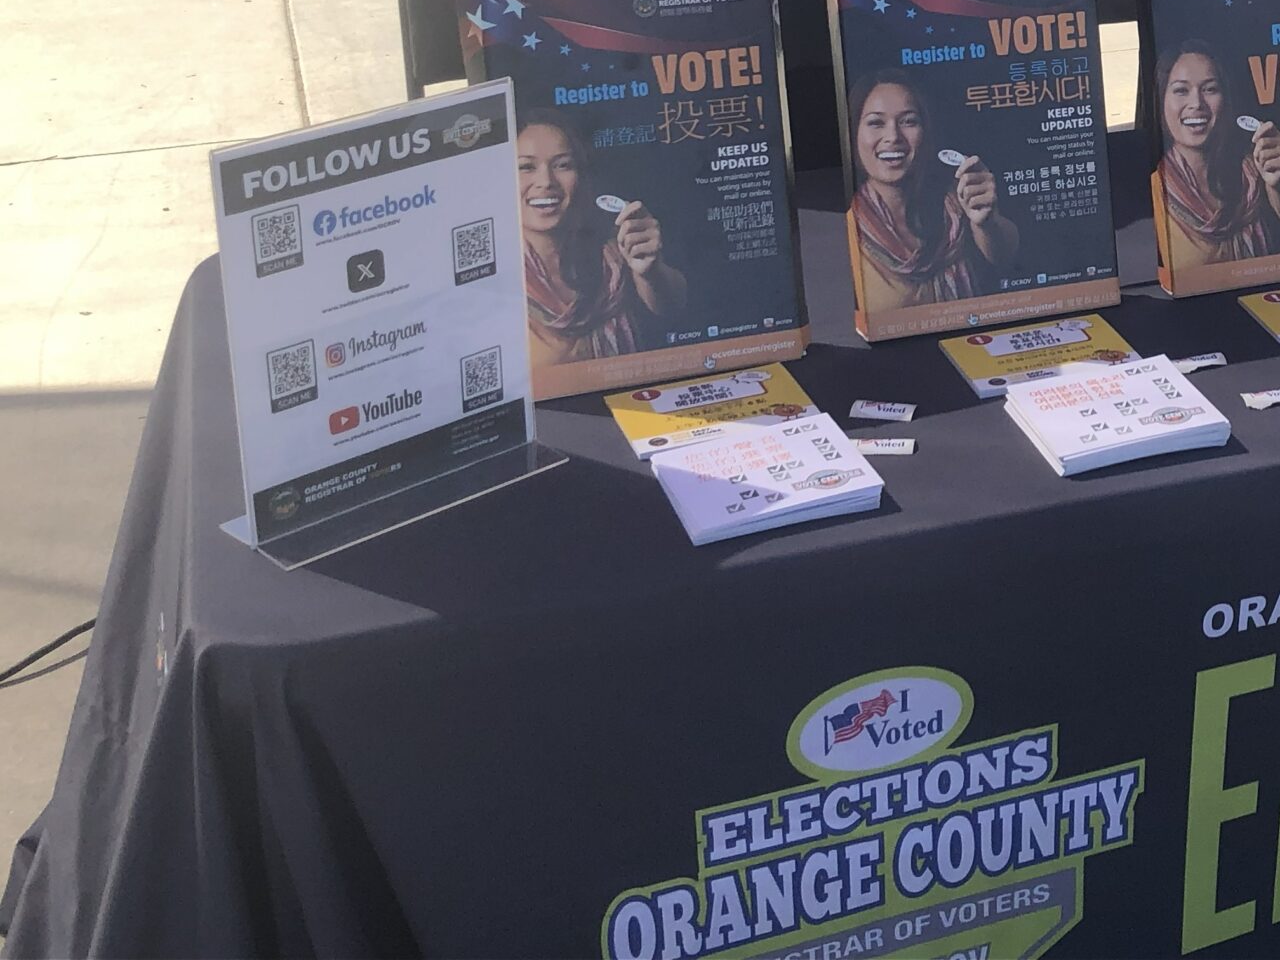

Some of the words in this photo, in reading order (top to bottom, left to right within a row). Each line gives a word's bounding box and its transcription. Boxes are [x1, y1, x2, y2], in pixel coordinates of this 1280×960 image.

[901, 45, 967, 66] Register
[969, 42, 986, 59] to
[988, 10, 1089, 57] VOTE!
[554, 83, 627, 106] Register
[630, 80, 650, 98] to
[651, 45, 764, 95] VOTE!
[964, 74, 1092, 113] 투표합시다!
[1041, 117, 1094, 133] UPDATED
[1047, 107, 1076, 119] KEEP
[1077, 104, 1093, 116] US
[242, 139, 382, 199] FOLLOW
[388, 127, 432, 161] US
[710, 155, 770, 172] UPDATED
[717, 144, 749, 157] KEEP
[750, 141, 769, 154] US
[1003, 168, 1036, 183] 귀하의
[1054, 174, 1098, 190] 하십시오
[338, 184, 438, 229] facebook
[458, 269, 480, 283] SCAN
[480, 264, 493, 277] ME
[347, 320, 428, 359] Instagram
[711, 339, 797, 360] ocvote.com/register
[361, 387, 424, 424] YouTube
[467, 396, 487, 410] SCAN
[487, 392, 500, 403] ME
[304, 475, 342, 496] ORANGE
[342, 461, 379, 483] COUNTY
[897, 688, 911, 715] I
[864, 708, 945, 750] Voted
[705, 735, 1051, 864] ELECTIONS
[608, 838, 882, 960] ORANGE
[897, 771, 1138, 896] COUNTY
[893, 912, 932, 942] OF
[937, 882, 1052, 929] VOTERS
